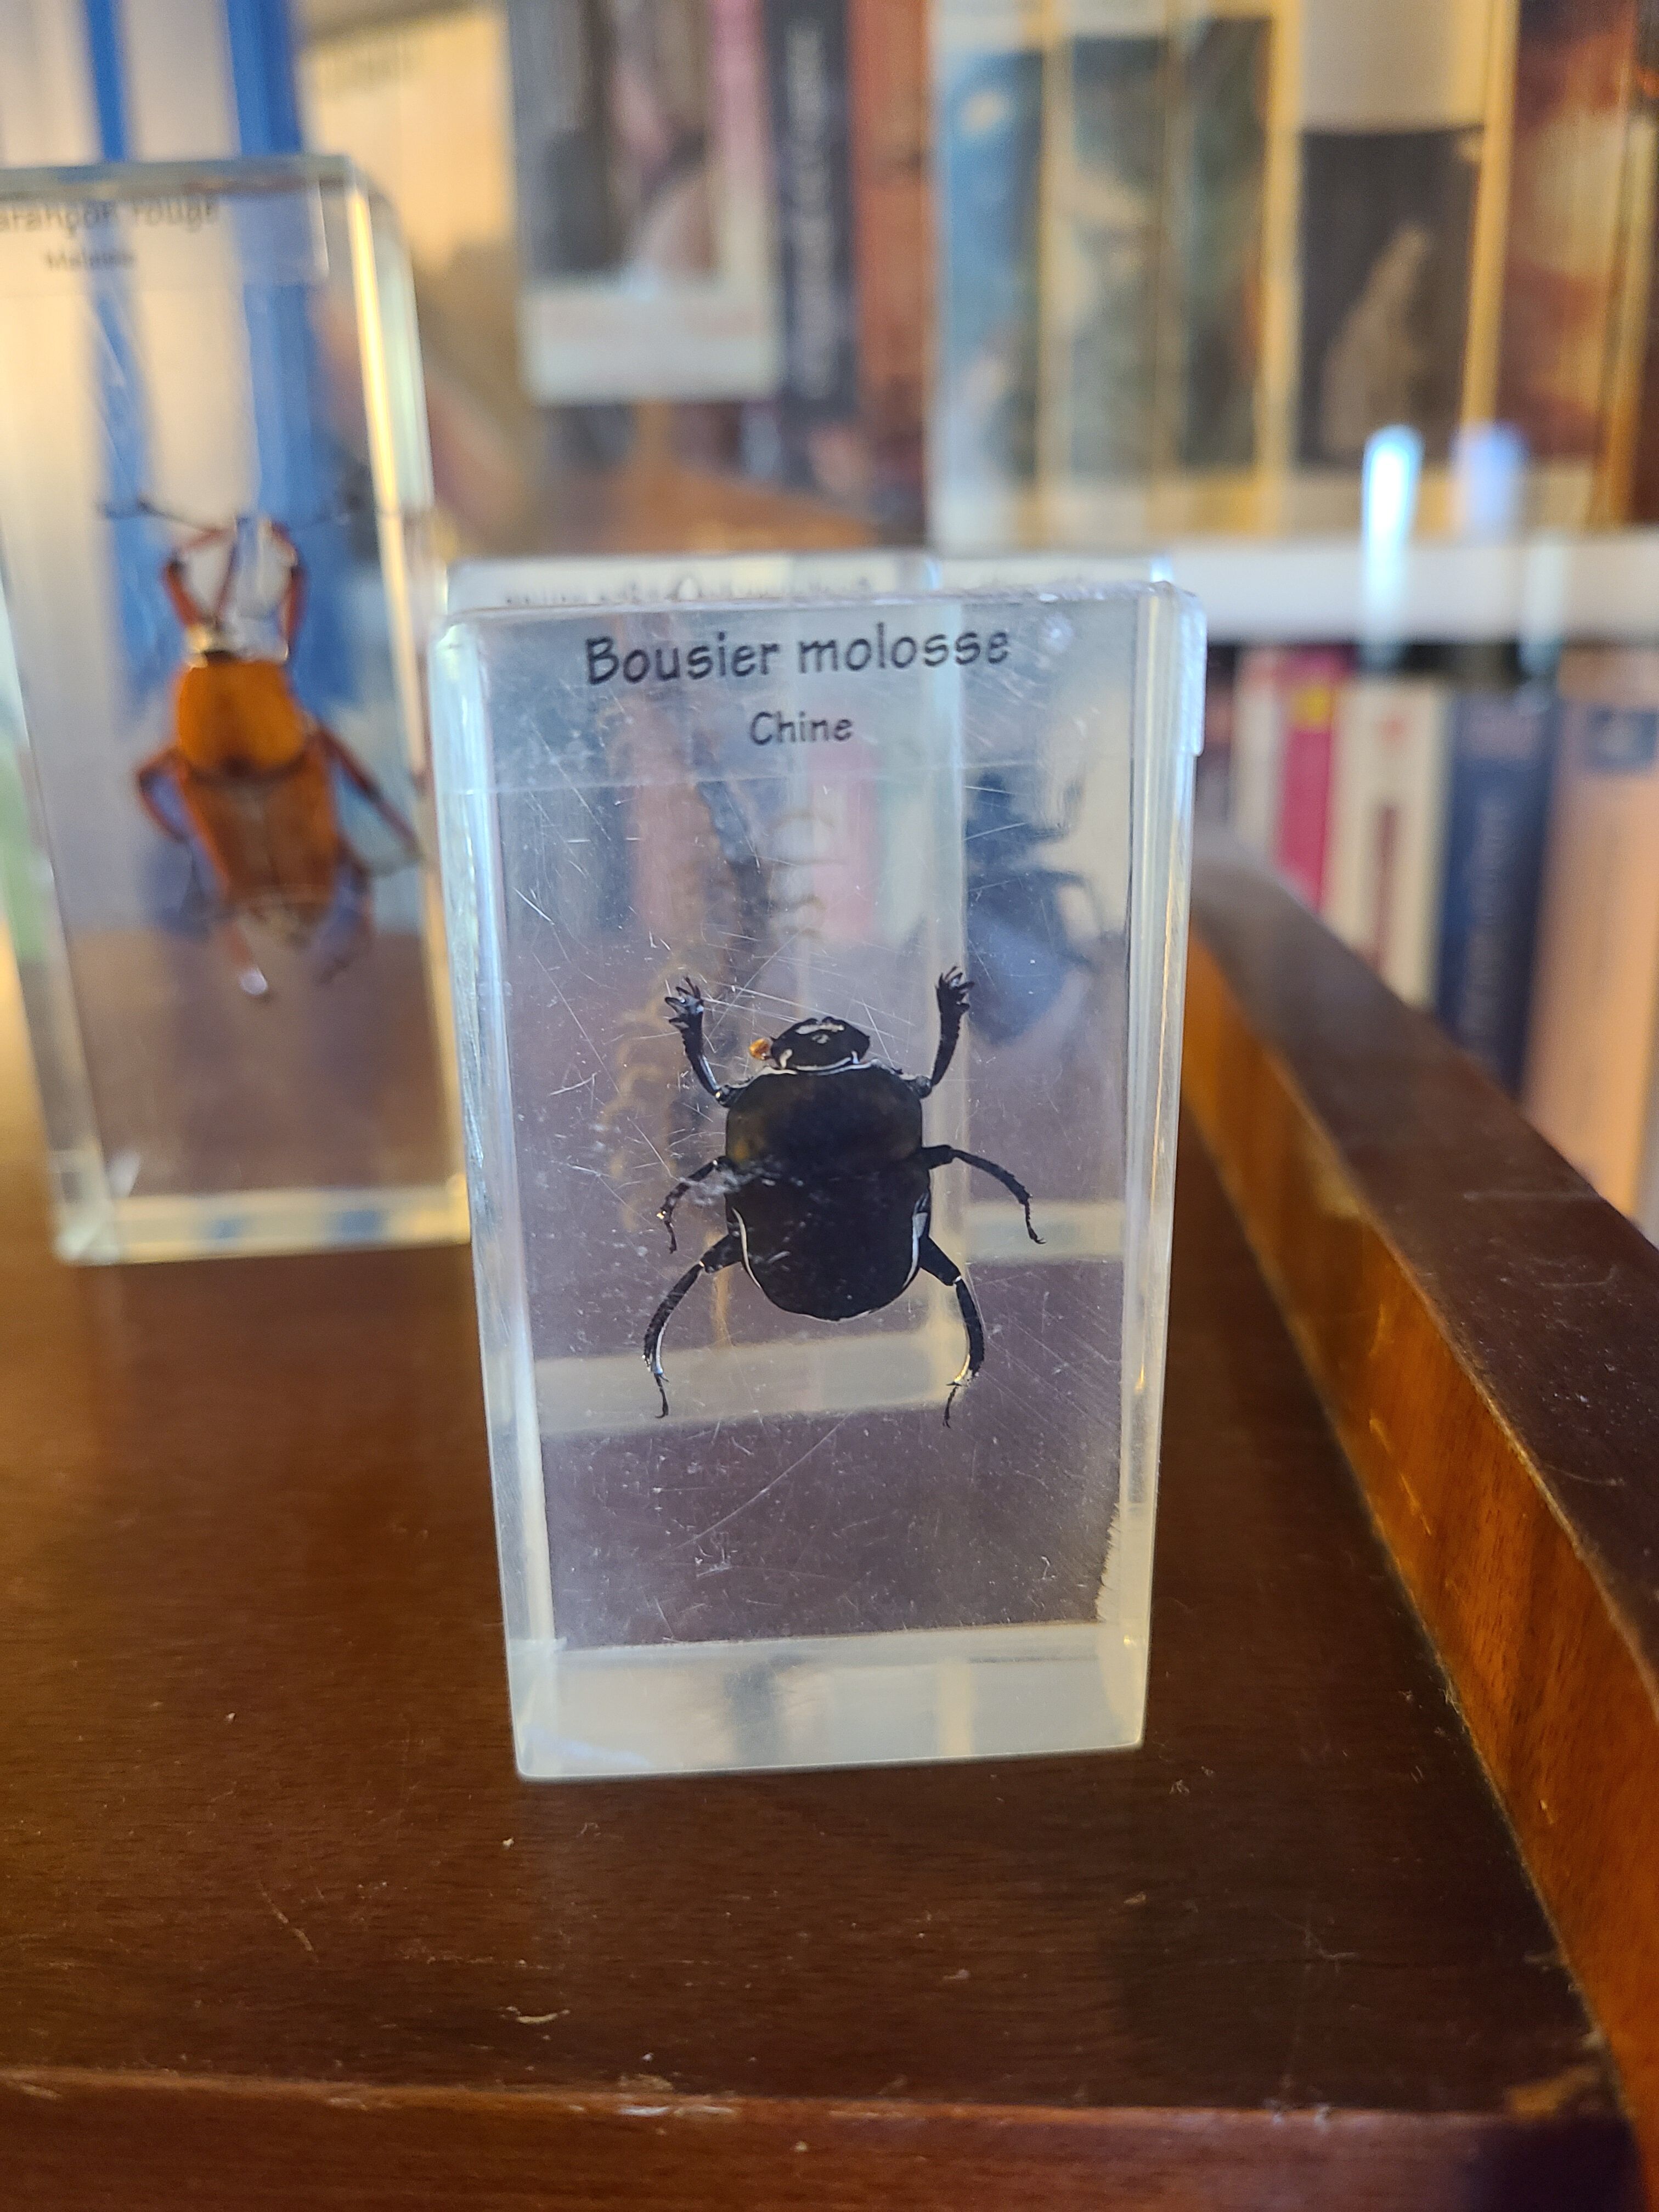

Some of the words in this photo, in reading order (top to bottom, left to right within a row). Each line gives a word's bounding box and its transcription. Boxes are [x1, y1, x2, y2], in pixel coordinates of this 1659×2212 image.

[585, 631, 781, 685] Bousier
[798, 621, 1009, 674] molosse
[749, 710, 854, 746] Chine
